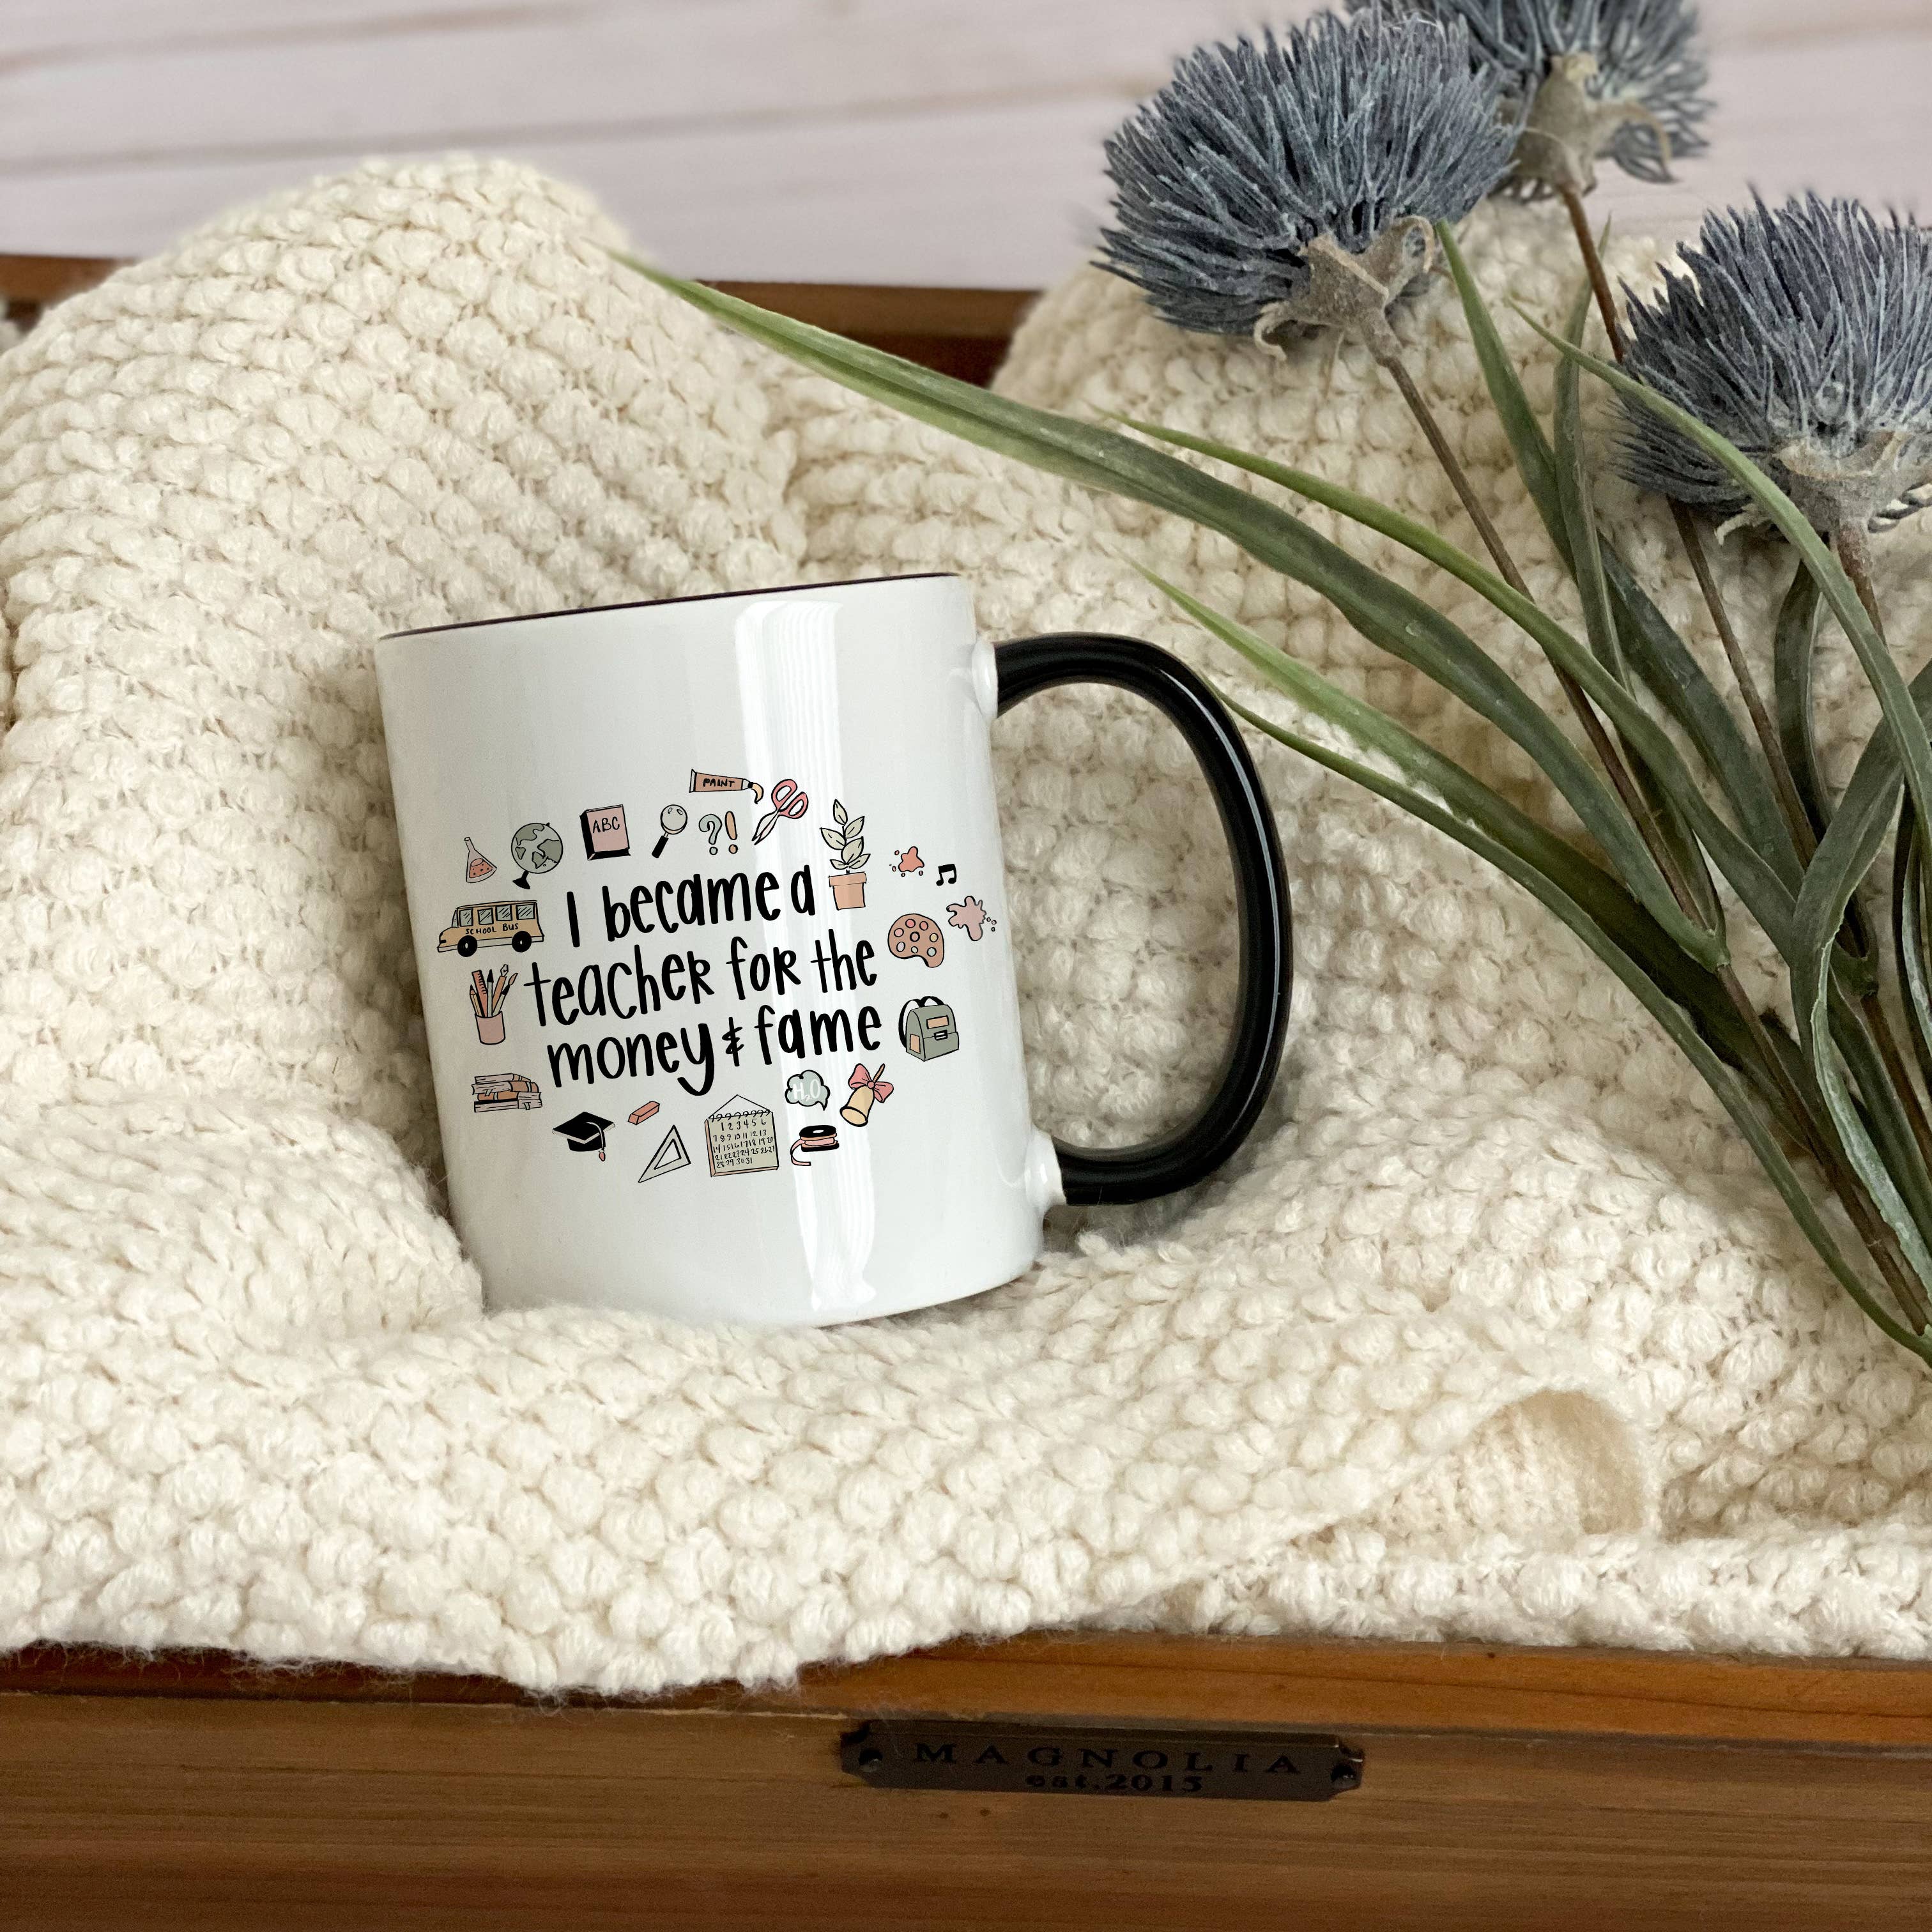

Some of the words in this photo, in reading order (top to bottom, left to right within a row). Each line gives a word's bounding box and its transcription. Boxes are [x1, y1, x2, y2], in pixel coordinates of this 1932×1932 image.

[703, 778, 735, 787] PAINT
[593, 816, 620, 833] ABC
[566, 891, 581, 948] I
[602, 871, 781, 942] became
[790, 864, 816, 916] a
[465, 926, 497, 935] SCHOOL
[502, 923, 519, 931] BUS
[810, 928, 878, 993] the
[546, 1023, 715, 1096] money
[721, 1016, 744, 1067] &
[754, 1004, 882, 1066] fame
[721, 1122, 724, 1131] 1
[737, 1121, 740, 1130] 3
[744, 1119, 749, 1128] 4
[713, 1144, 721, 1153] 14
[915, 1742, 1301, 1774] MAGNOLIA
